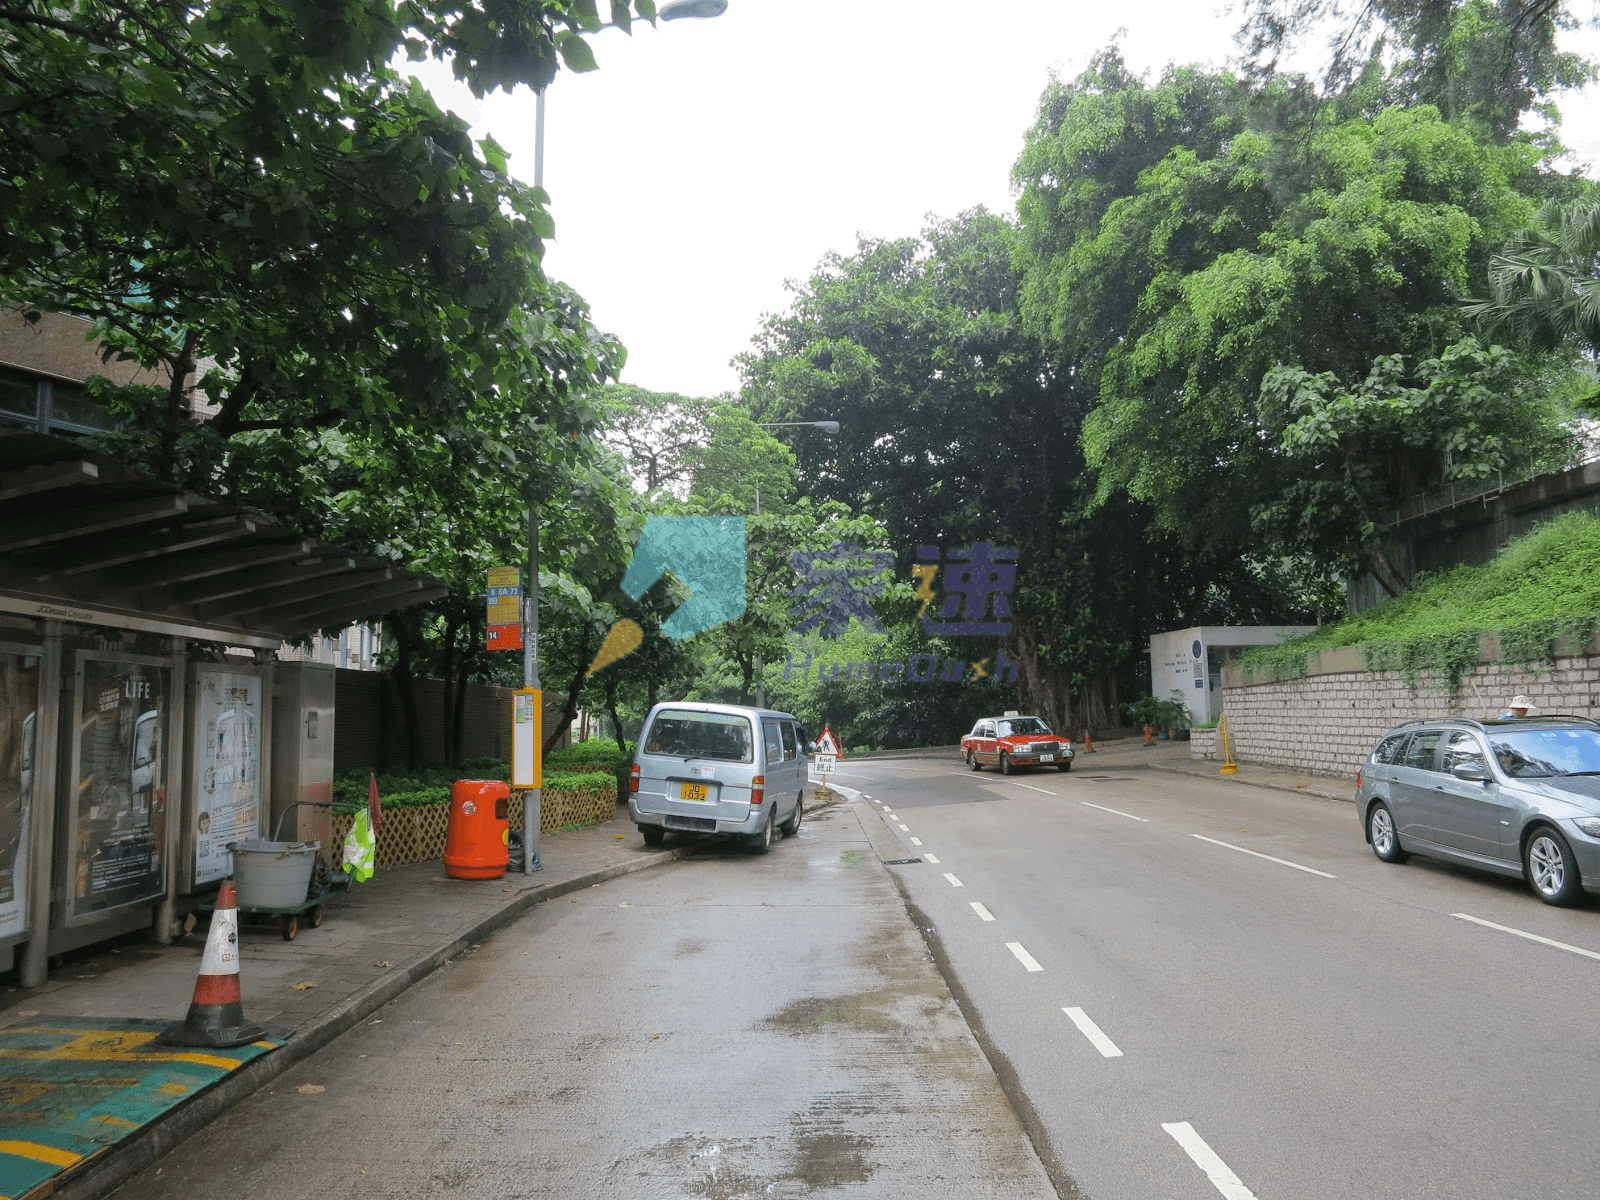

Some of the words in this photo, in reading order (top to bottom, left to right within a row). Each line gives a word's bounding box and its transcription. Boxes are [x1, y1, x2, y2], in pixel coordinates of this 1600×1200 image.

[509, 587, 518, 595] 73
[37, 605, 68, 617] JCDecaux
[488, 631, 498, 639] 14
[125, 681, 151, 699] LIFE
[816, 763, 834, 773] 終止
[689, 785, 701, 793] JD
[683, 792, 706, 801] 1033
